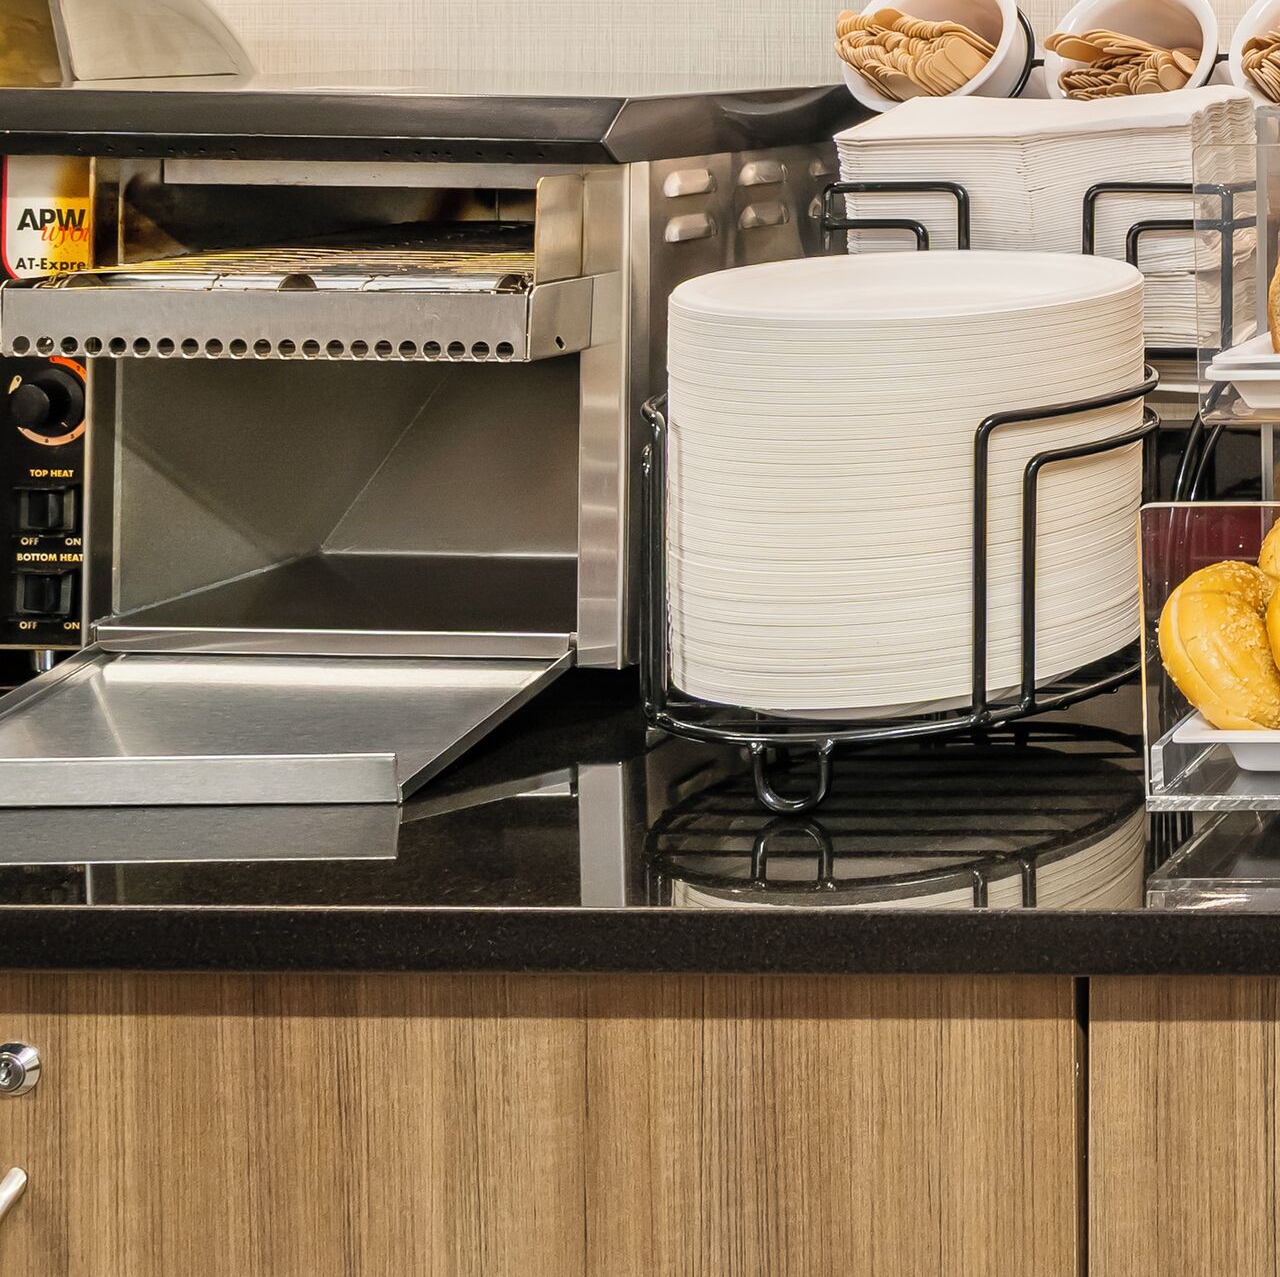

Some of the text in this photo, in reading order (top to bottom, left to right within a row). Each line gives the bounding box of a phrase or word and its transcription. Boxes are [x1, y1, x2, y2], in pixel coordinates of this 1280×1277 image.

[16, 207, 86, 231] APW
[29, 469, 75, 478] TOP HEAT
[20, 537, 40, 546] OFF
[65, 537, 82, 546] ON
[16, 553, 84, 563] BOTTOM HEAT
[19, 620, 38, 630] OFF
[63, 621, 81, 630] ON
